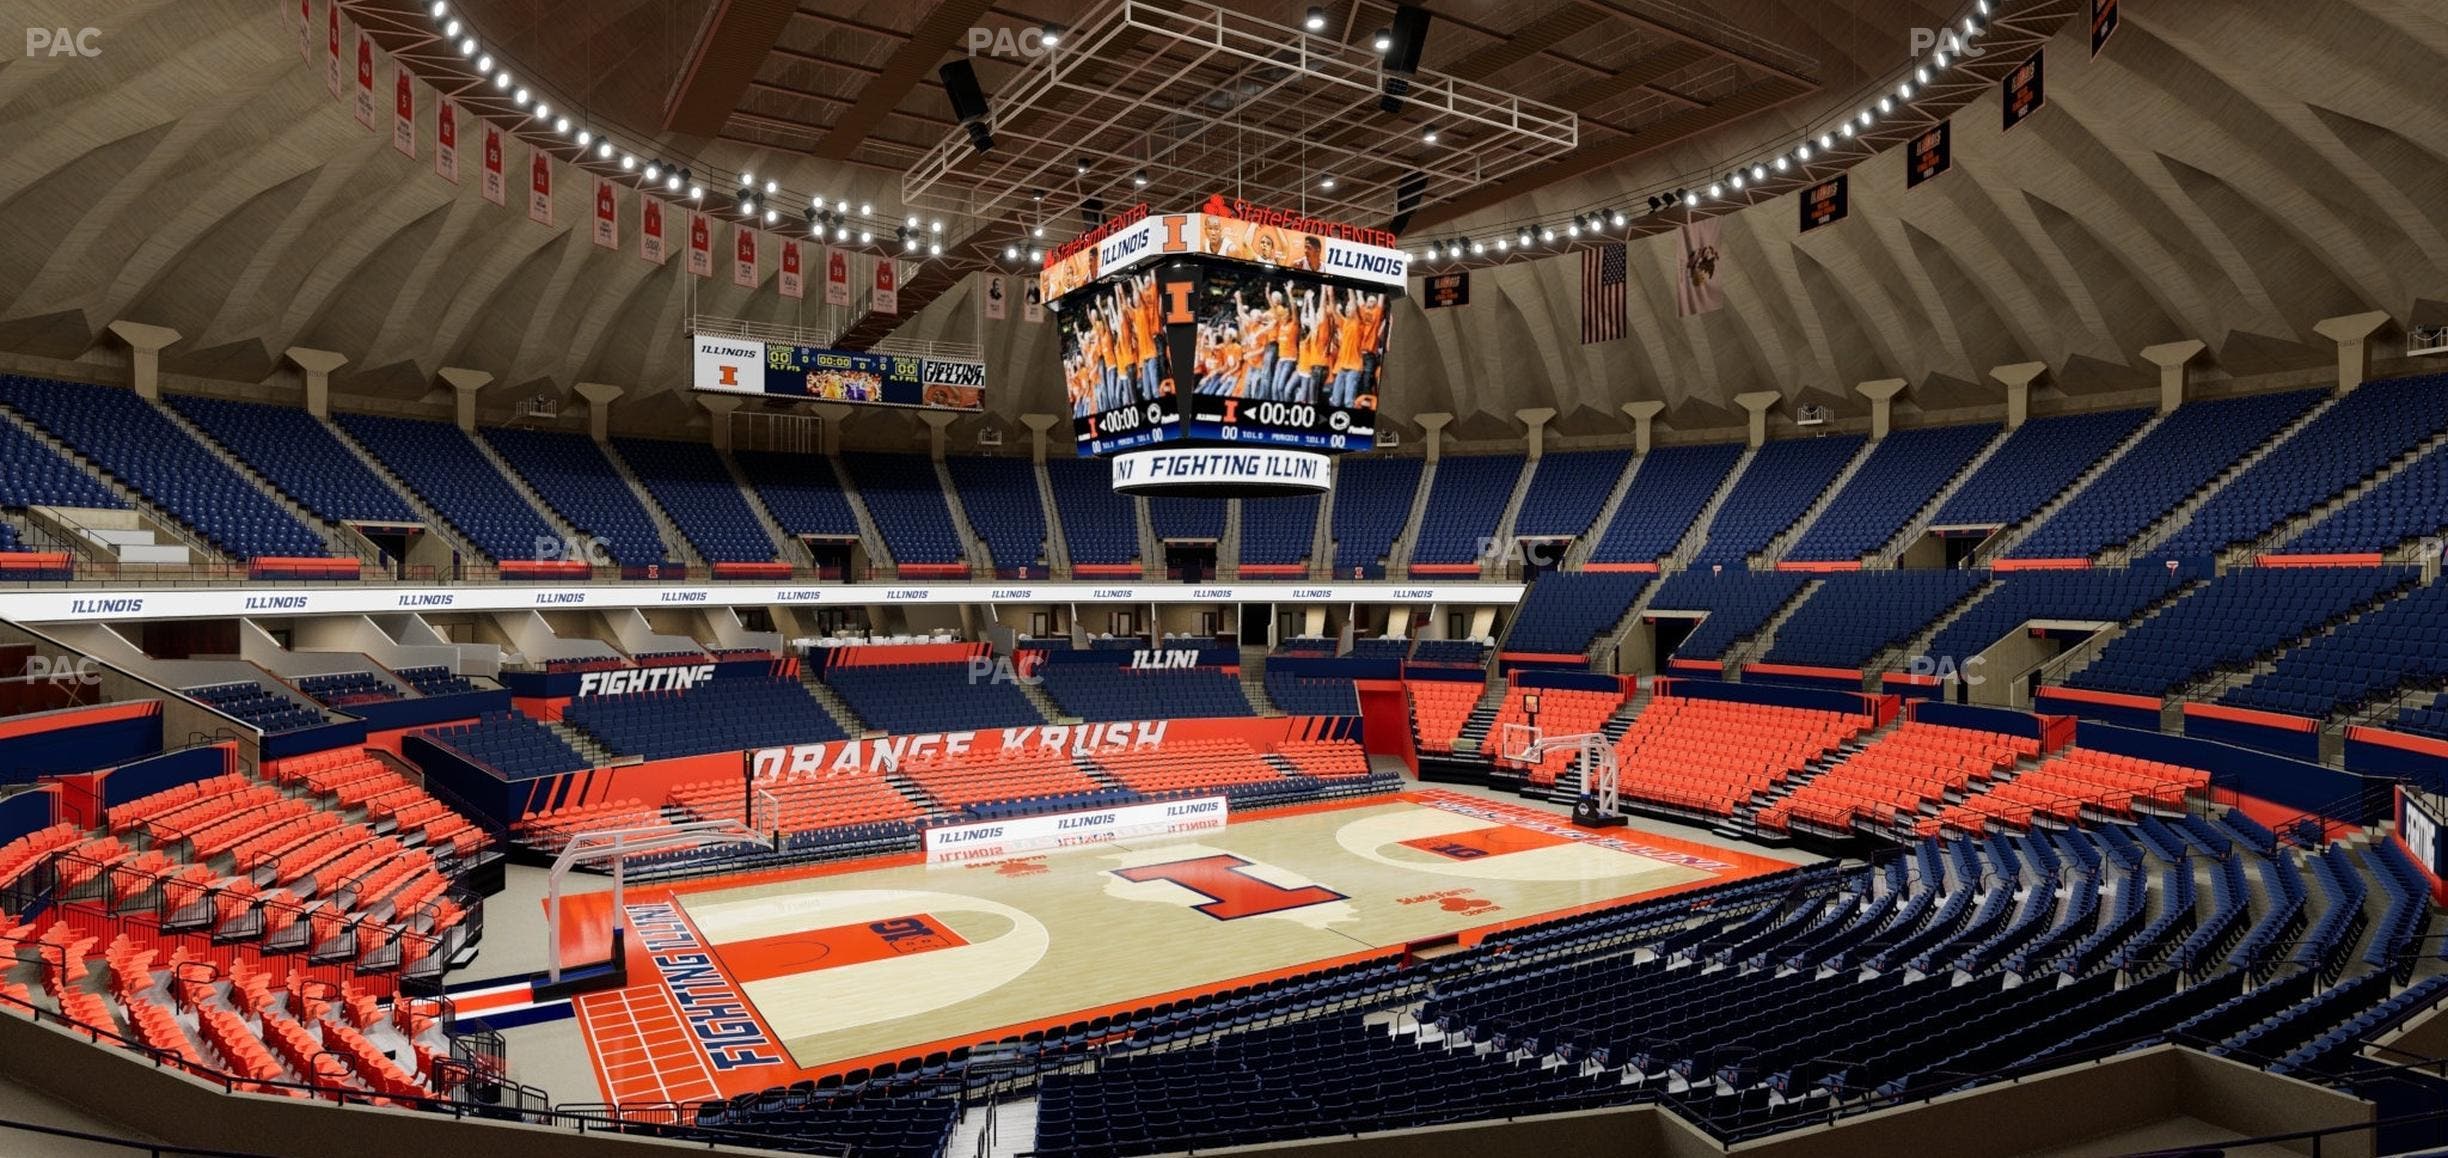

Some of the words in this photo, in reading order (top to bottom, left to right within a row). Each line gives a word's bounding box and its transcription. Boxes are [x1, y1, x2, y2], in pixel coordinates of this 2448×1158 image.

[1102, 228, 1149, 267] ILLINOIS
[1327, 247, 1404, 276] ILLINOIS
[701, 345, 756, 359] ILLINOIS
[770, 351, 789, 363] 00
[819, 356, 849, 367] 00:00
[926, 361, 984, 376] FIGHTING
[897, 364, 916, 374] 00
[1106, 406, 1139, 433] 00:00
[1259, 402, 1315, 427] 00:00
[1221, 425, 1238, 440] 00
[1330, 434, 1346, 448] 00
[1150, 455, 1261, 477] FIGHTING
[1265, 456, 1318, 479] ILLINI
[398, 594, 454, 606] ILLINOIS
[536, 592, 585, 603] ILLINOIS
[661, 591, 707, 602] ILLINOIS
[777, 591, 821, 601] ILLINOIS
[886, 590, 928, 599] ILLINOIS
[991, 590, 1032, 599] ILLINOIS
[1093, 589, 1132, 598] ILLINOIS
[1193, 589, 1232, 598] ILLINOIS
[1292, 589, 1332, 598] ILLINOIS
[1393, 589, 1433, 598] ILLINOIS
[71, 599, 143, 614] ILLINOIS
[245, 596, 308, 610] ILLINOIS
[578, 664, 716, 697] FIGHTING
[1131, 650, 1199, 669] ILLINI
[752, 732, 976, 784] ORANGE
[998, 719, 1169, 760] KRUSH
[1167, 801, 1219, 817] ILLINOIS
[1058, 813, 1115, 829] ILLINOIS
[939, 827, 1004, 844] ILLINOIS
[623, 901, 701, 953] ILLINI
[653, 953, 784, 1072] FIGHTING
